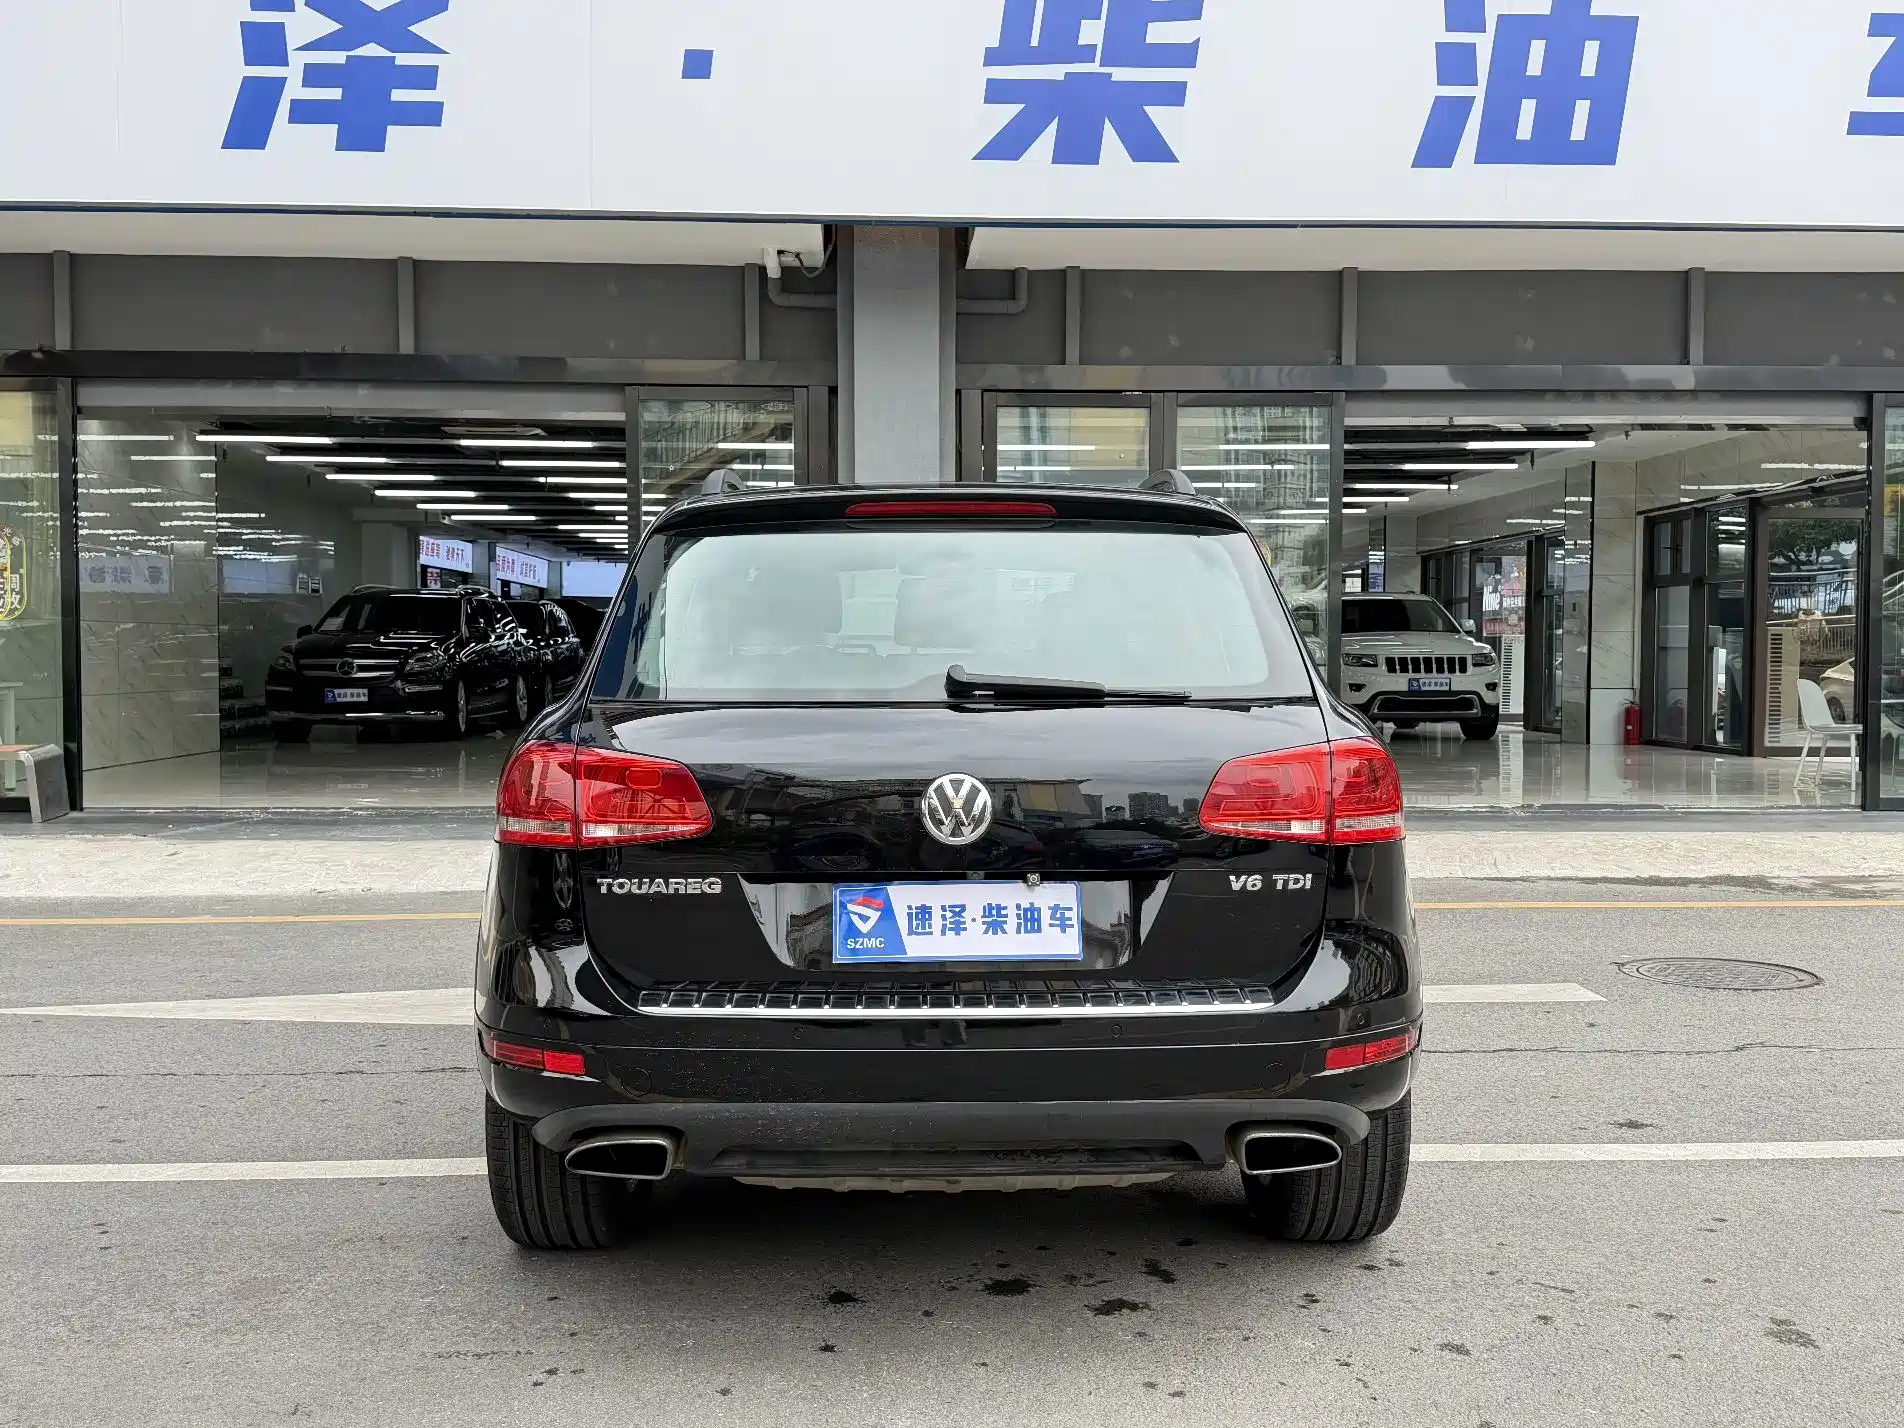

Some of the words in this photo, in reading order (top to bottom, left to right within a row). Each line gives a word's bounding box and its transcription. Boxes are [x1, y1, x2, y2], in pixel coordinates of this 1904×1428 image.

[597, 877, 722, 894] TOUAREG
[1229, 874, 1263, 891] V6
[1272, 873, 1313, 890] TDI
[906, 902, 1075, 937] 速泽·柴油车
[846, 937, 885, 950] SZMC
